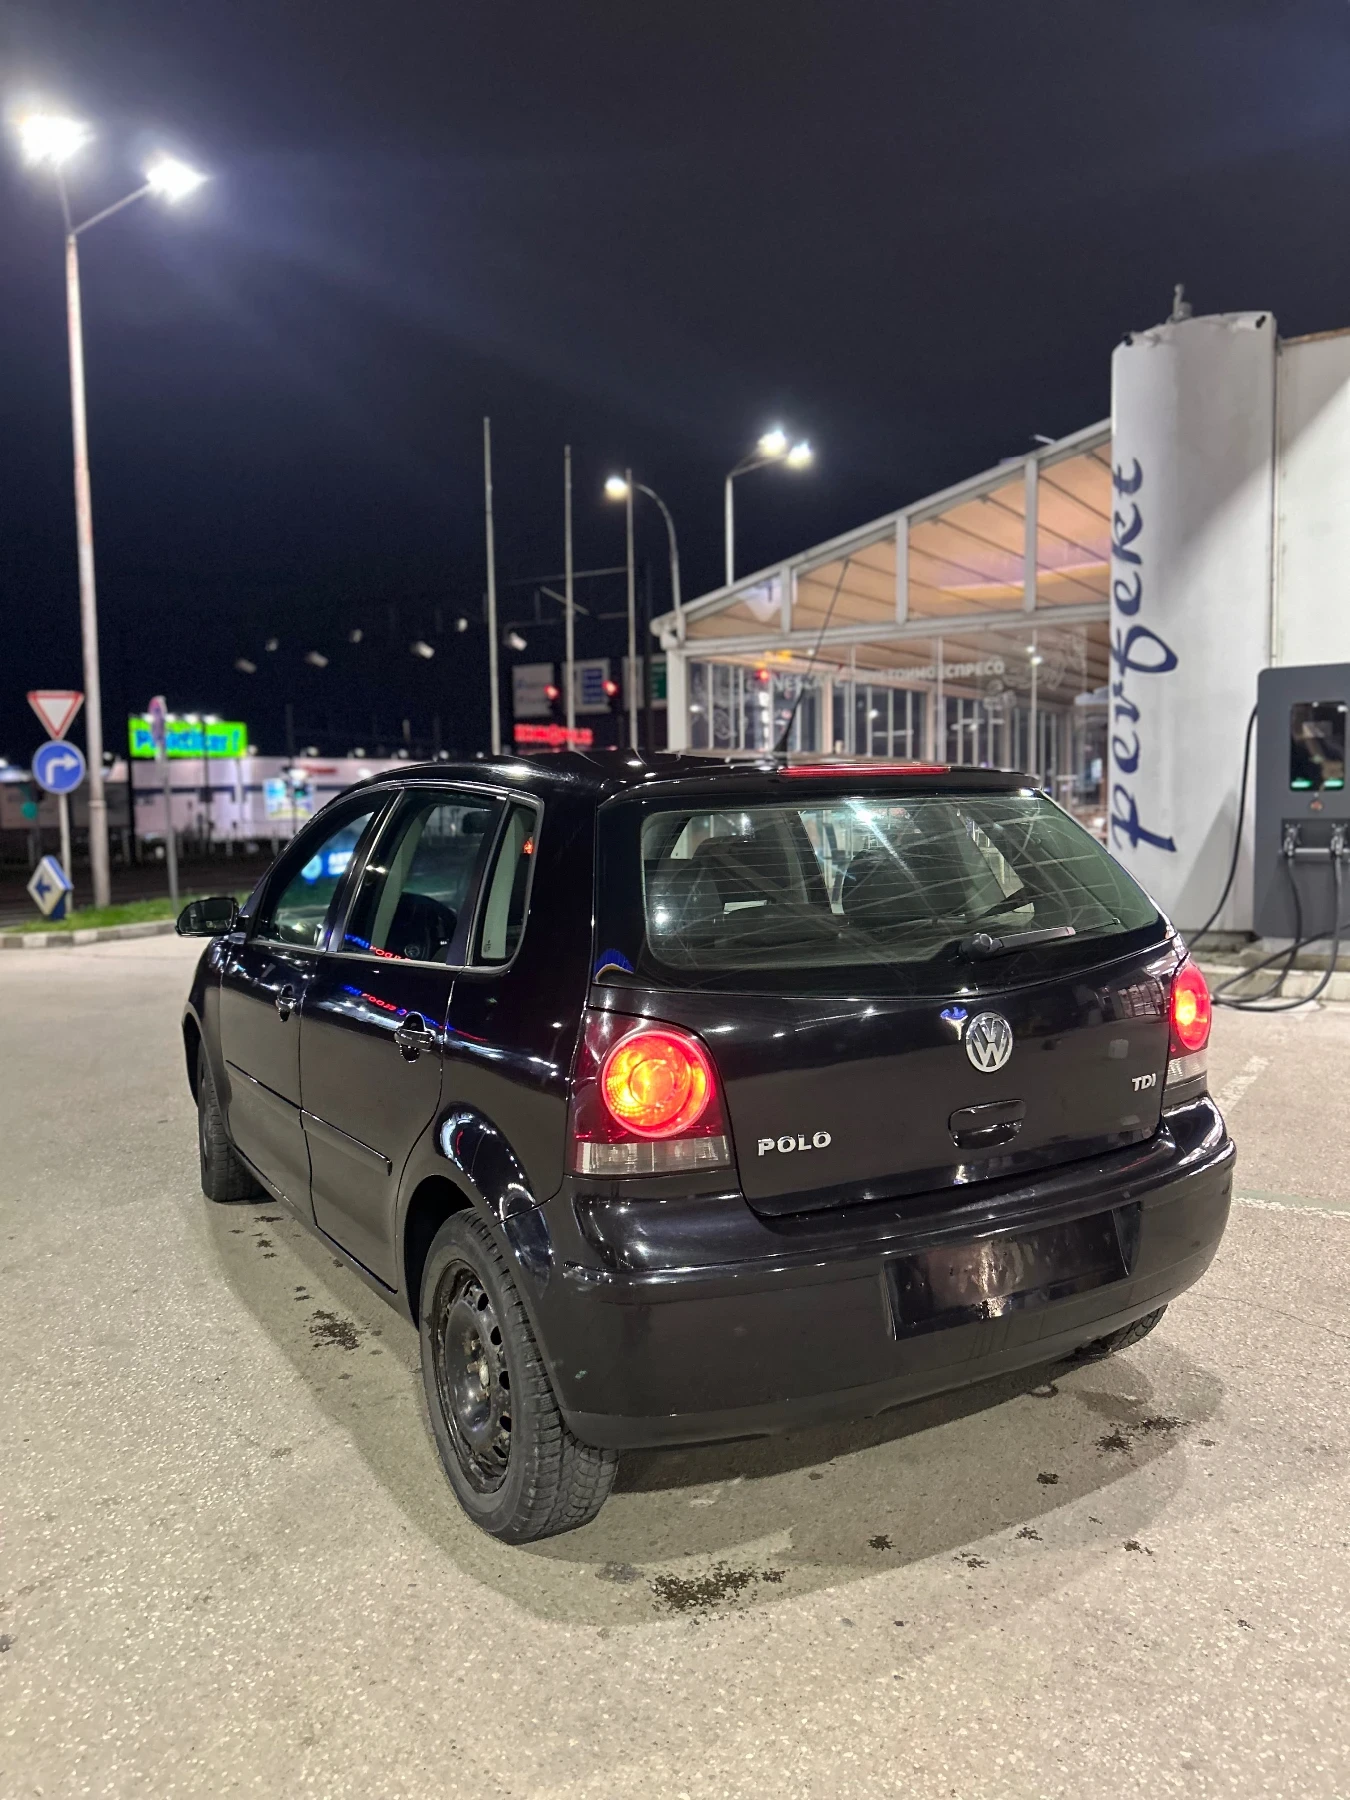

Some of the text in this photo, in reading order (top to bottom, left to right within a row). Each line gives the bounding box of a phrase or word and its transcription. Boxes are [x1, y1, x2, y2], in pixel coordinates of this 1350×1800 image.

[1110, 457, 1178, 852] perfekt
[966, 1012, 1012, 1073] VW
[1131, 1073, 1157, 1092] TDI
[757, 1130, 832, 1157] POLO
